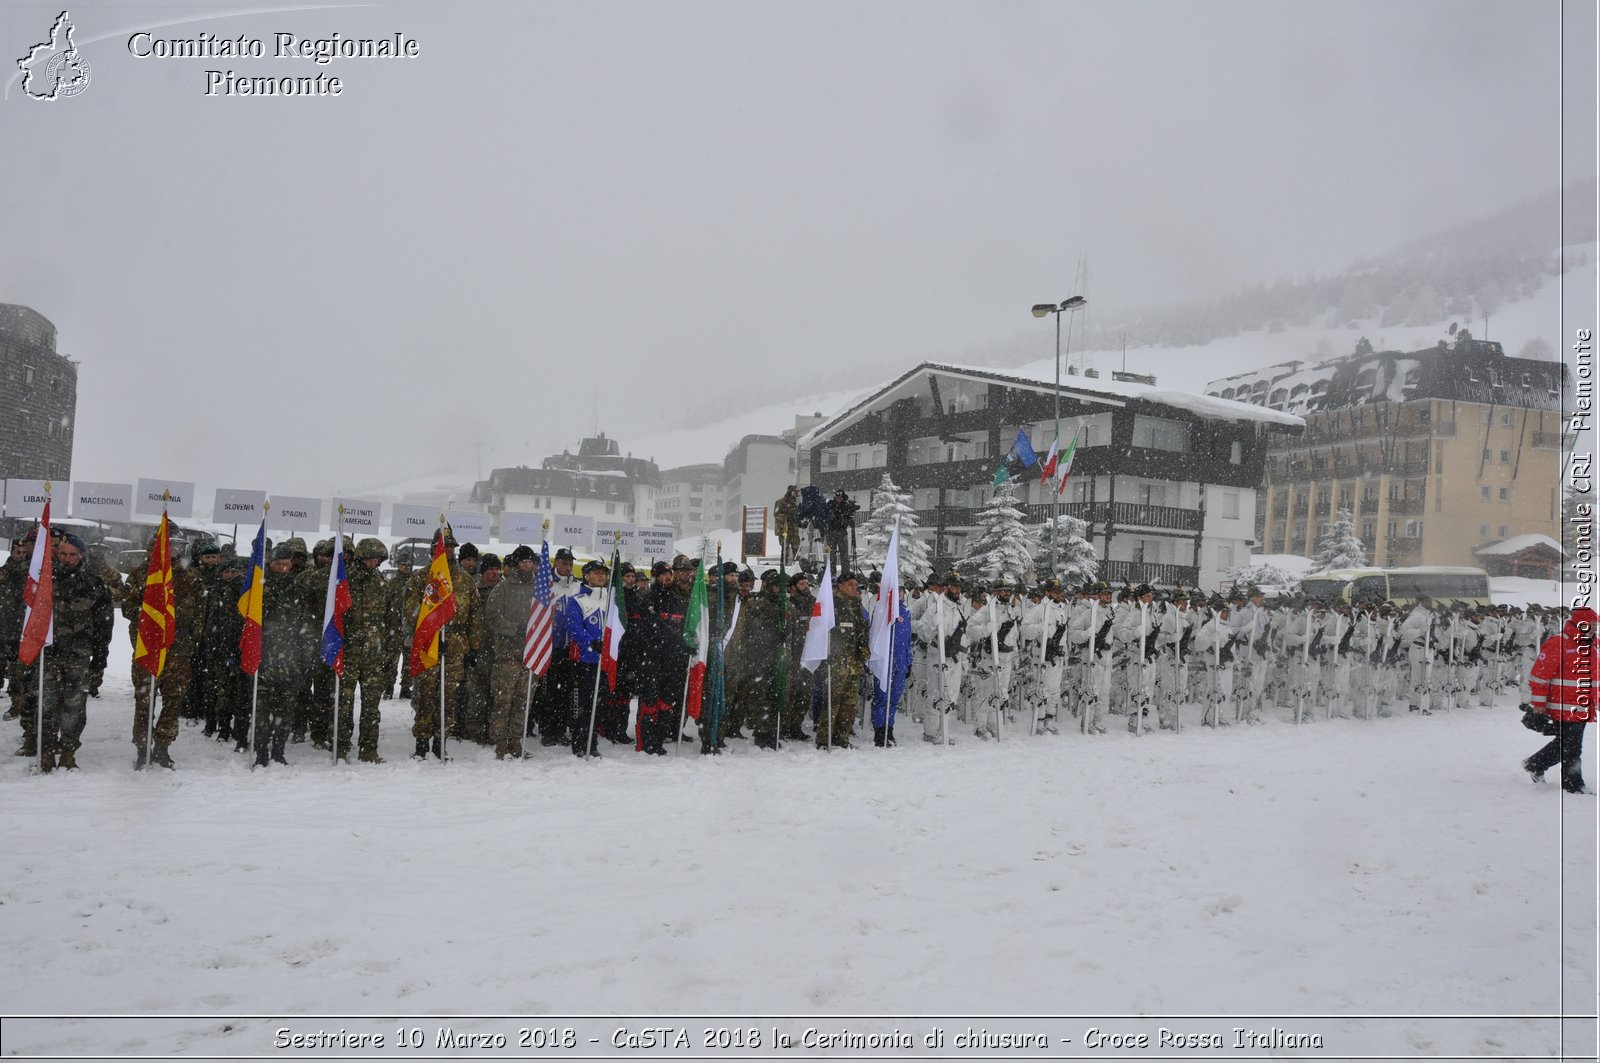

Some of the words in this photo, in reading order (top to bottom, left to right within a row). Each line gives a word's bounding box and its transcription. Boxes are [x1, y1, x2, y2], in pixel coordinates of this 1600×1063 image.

[23, 495, 51, 503] LIBAN
[80, 496, 124, 506] MACEDONIA
[148, 493, 181, 503] ROMNIA
[224, 503, 254, 512] SLOVENIA
[343, 507, 356, 516] TATI
[356, 509, 373, 517] UNITI
[281, 510, 308, 518] SPAGNA
[406, 517, 426, 525] ITALIA
